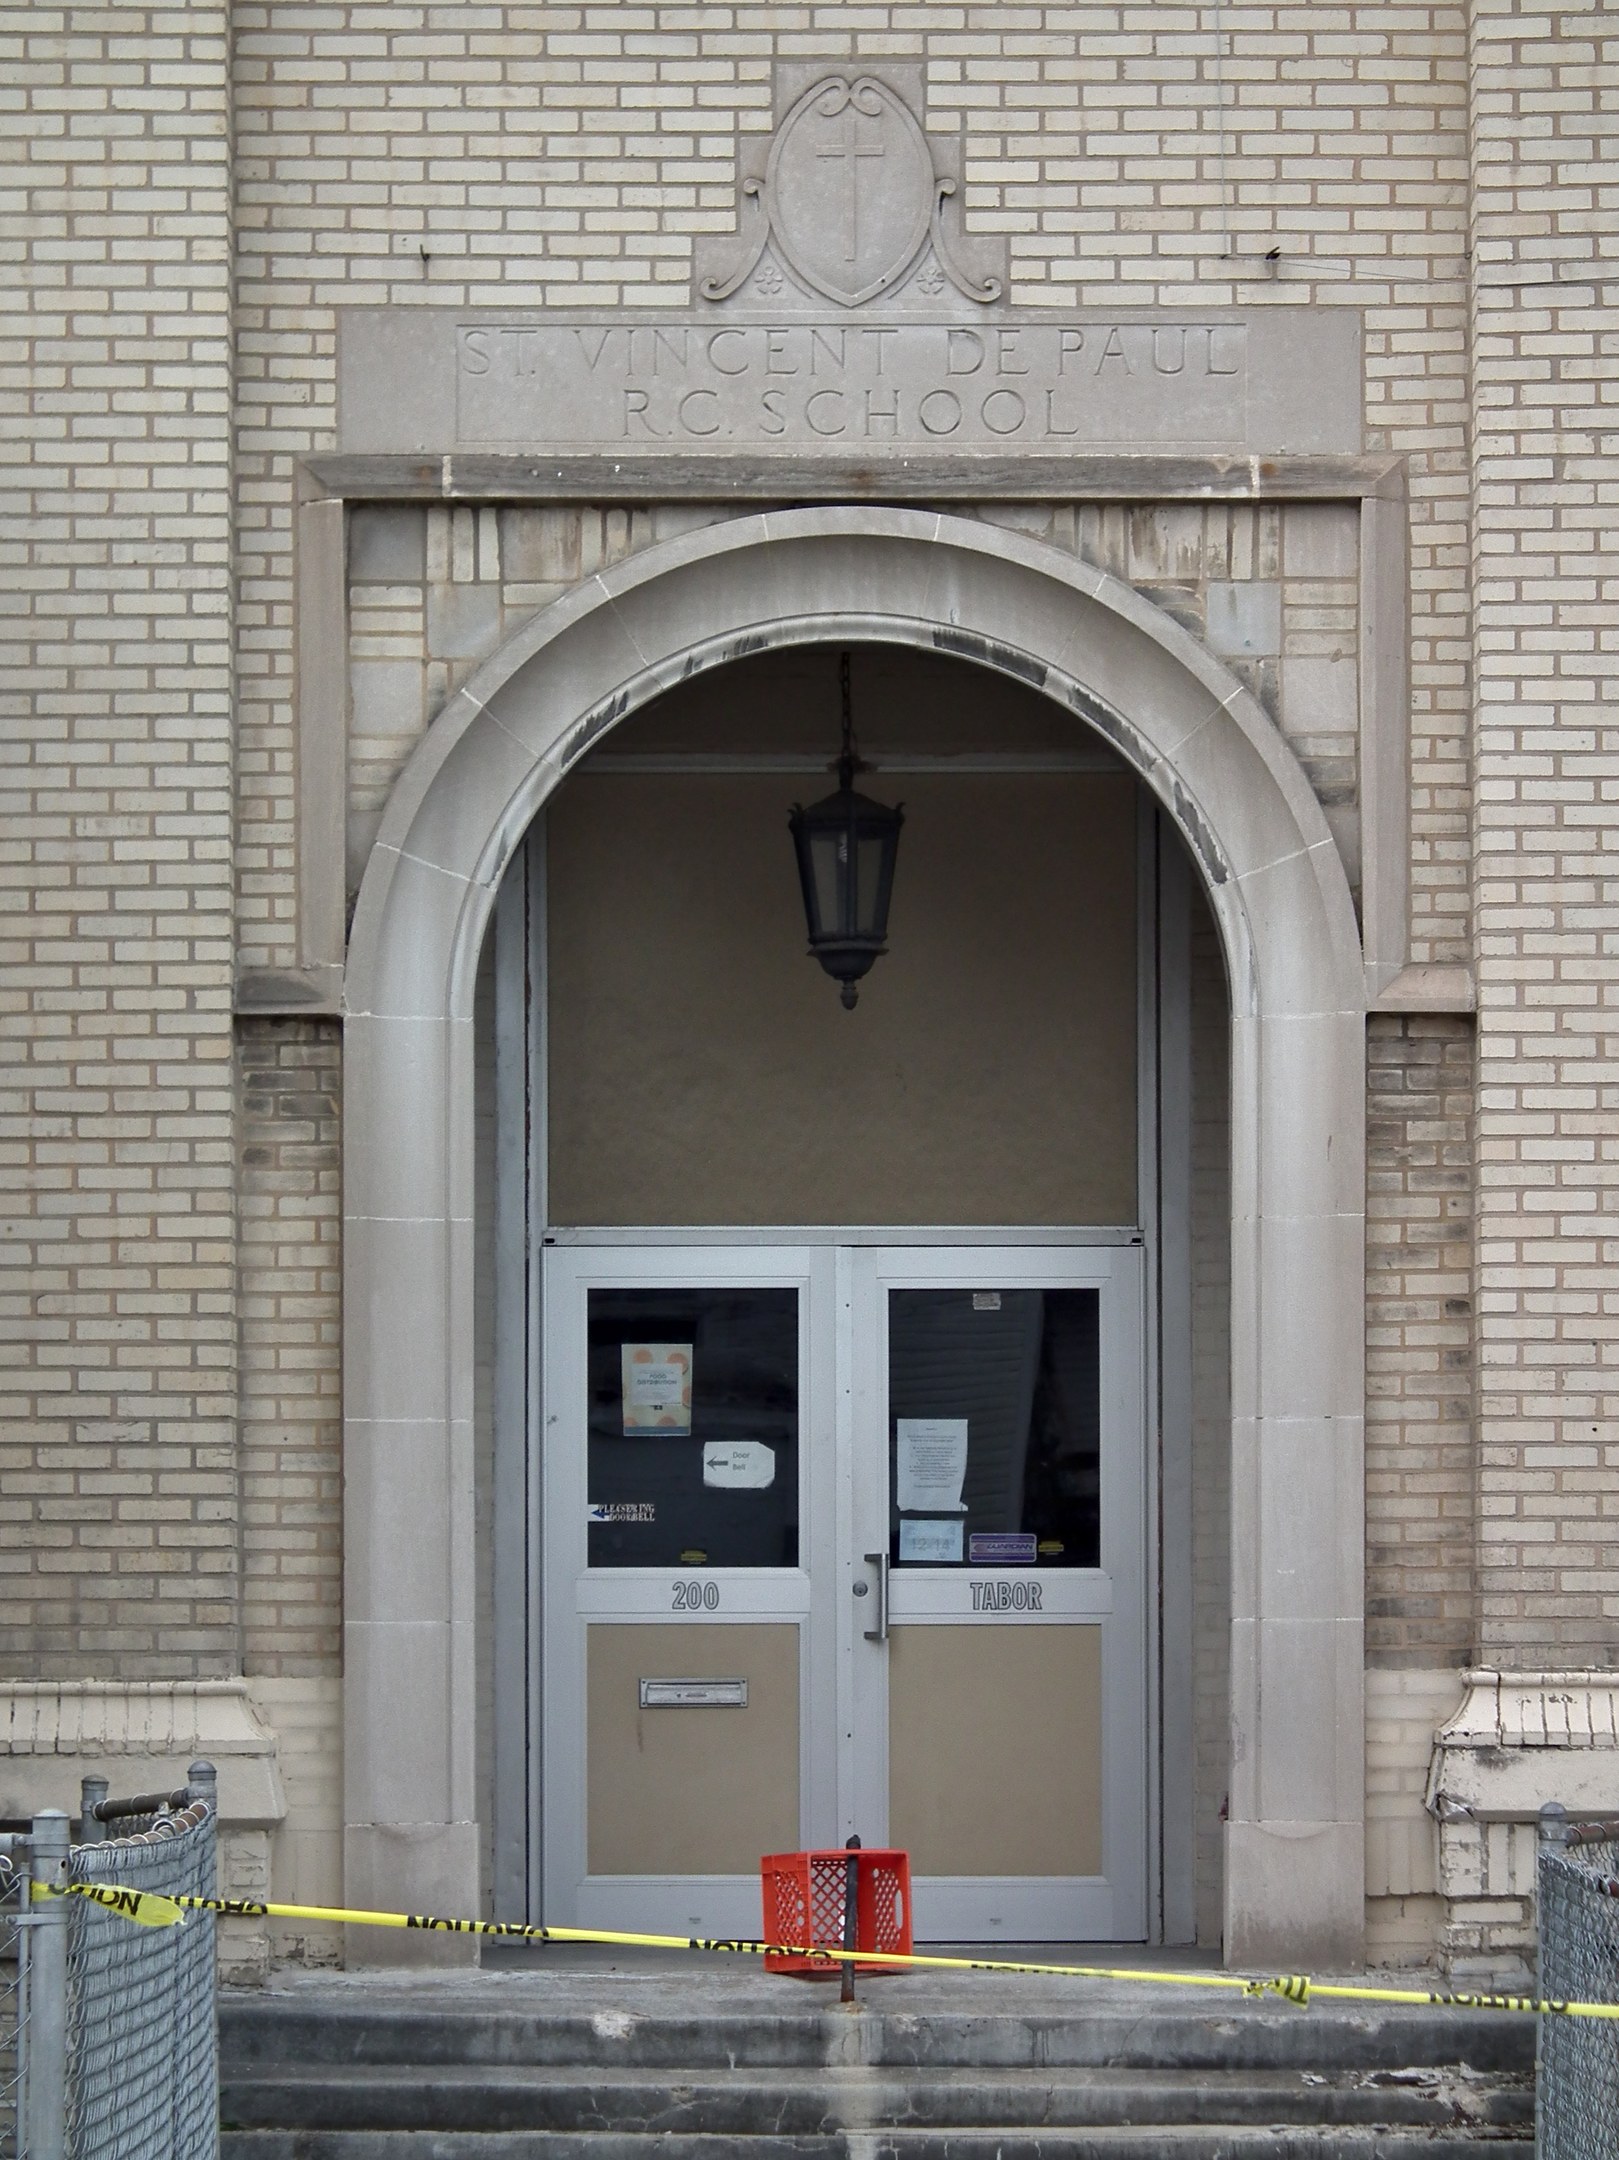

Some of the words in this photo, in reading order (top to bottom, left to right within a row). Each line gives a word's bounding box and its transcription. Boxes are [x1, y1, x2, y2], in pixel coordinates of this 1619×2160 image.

[462, 328, 537, 376] ST.
[571, 328, 893, 376] VINCENT
[946, 328, 1029, 376] DE
[1058, 328, 1242, 376] PAUL
[622, 388, 734, 438] R.C.
[759, 388, 1081, 438] SCHOOL
[732, 1451, 750, 1459] Door
[672, 1581, 720, 1611] 200
[969, 1581, 1043, 1611] TABOR
